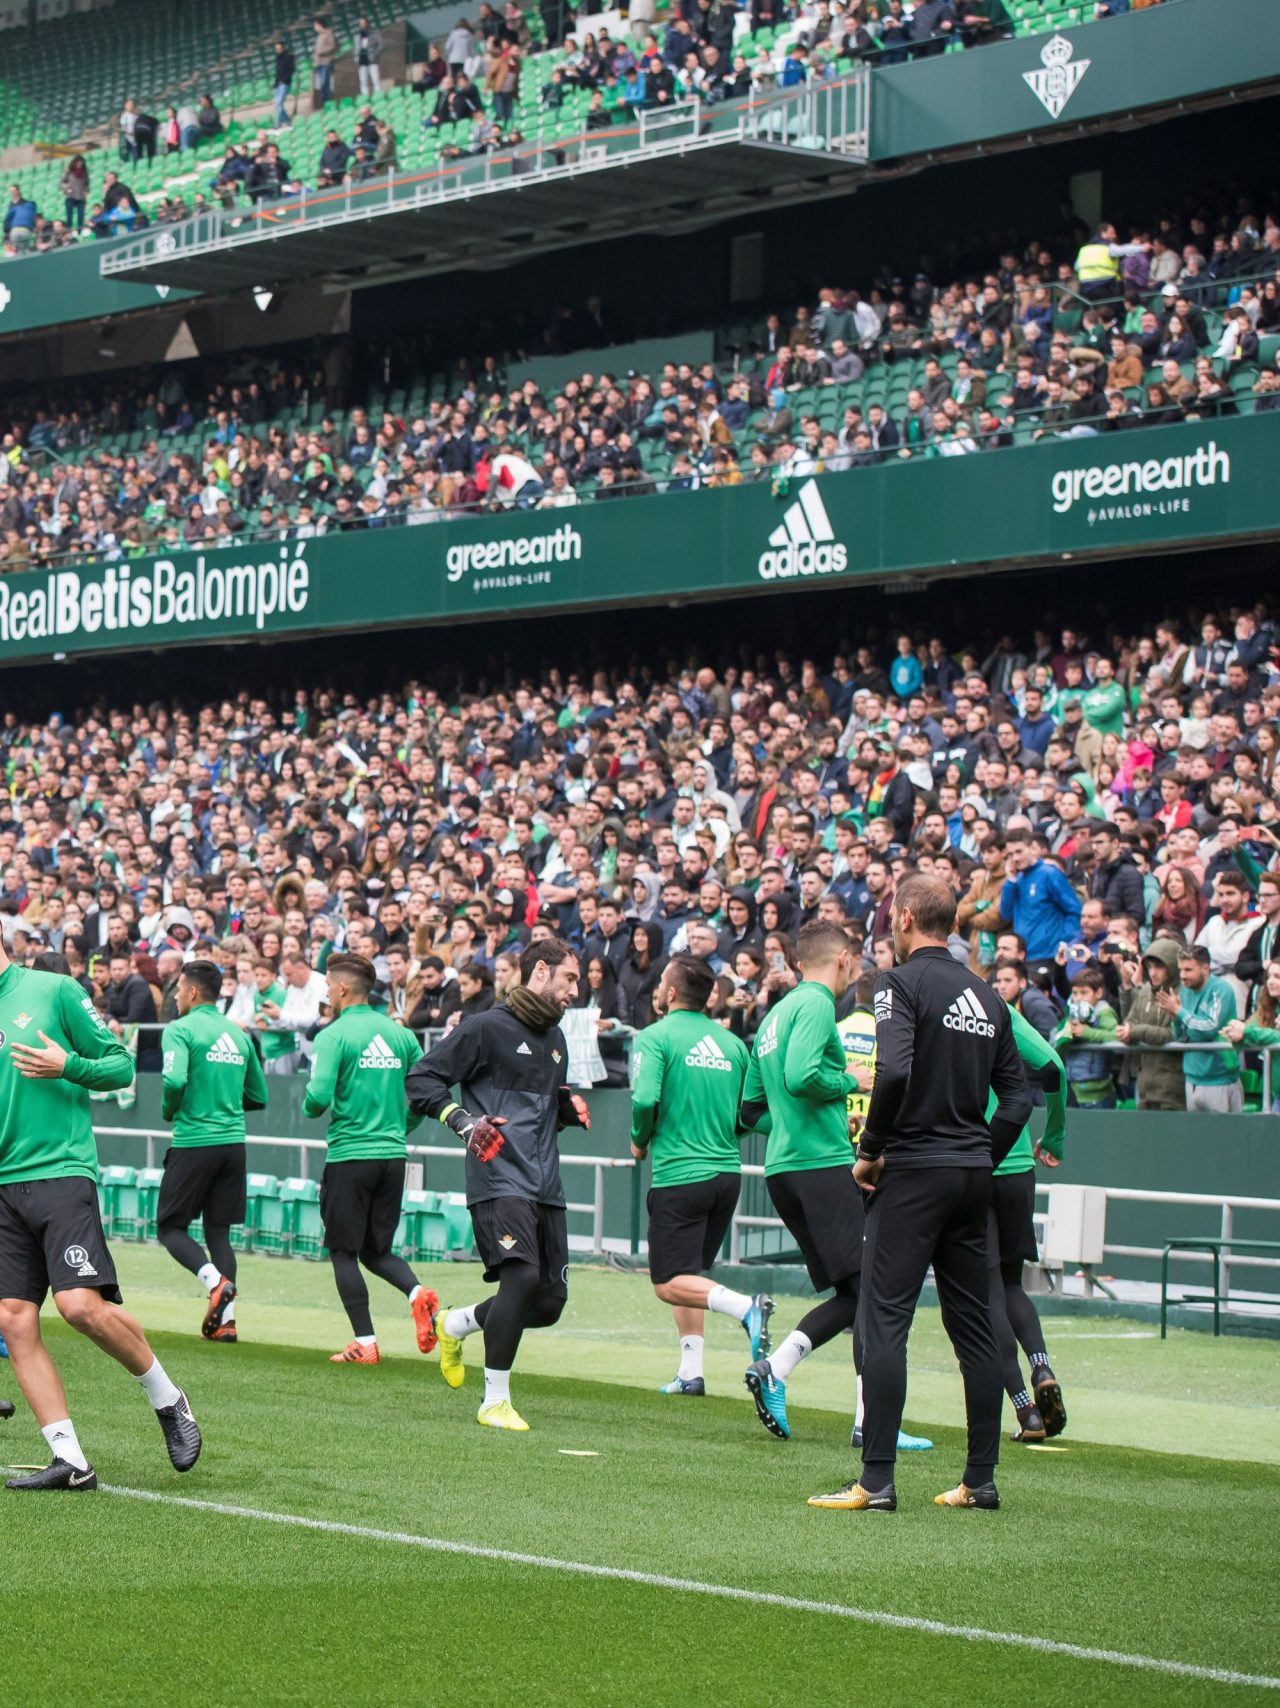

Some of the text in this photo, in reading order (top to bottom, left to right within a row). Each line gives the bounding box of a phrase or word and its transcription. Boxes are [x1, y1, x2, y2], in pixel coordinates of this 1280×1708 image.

[1051, 441, 1230, 513] greenearth
[446, 523, 582, 582] greenearth
[758, 540, 847, 580] adidas
[943, 1013, 996, 1038] adidas
[205, 1050, 245, 1066] adidas
[359, 1055, 402, 1069] adidas
[685, 1053, 733, 1072] adidas
[69, 1249, 84, 1264] 12
